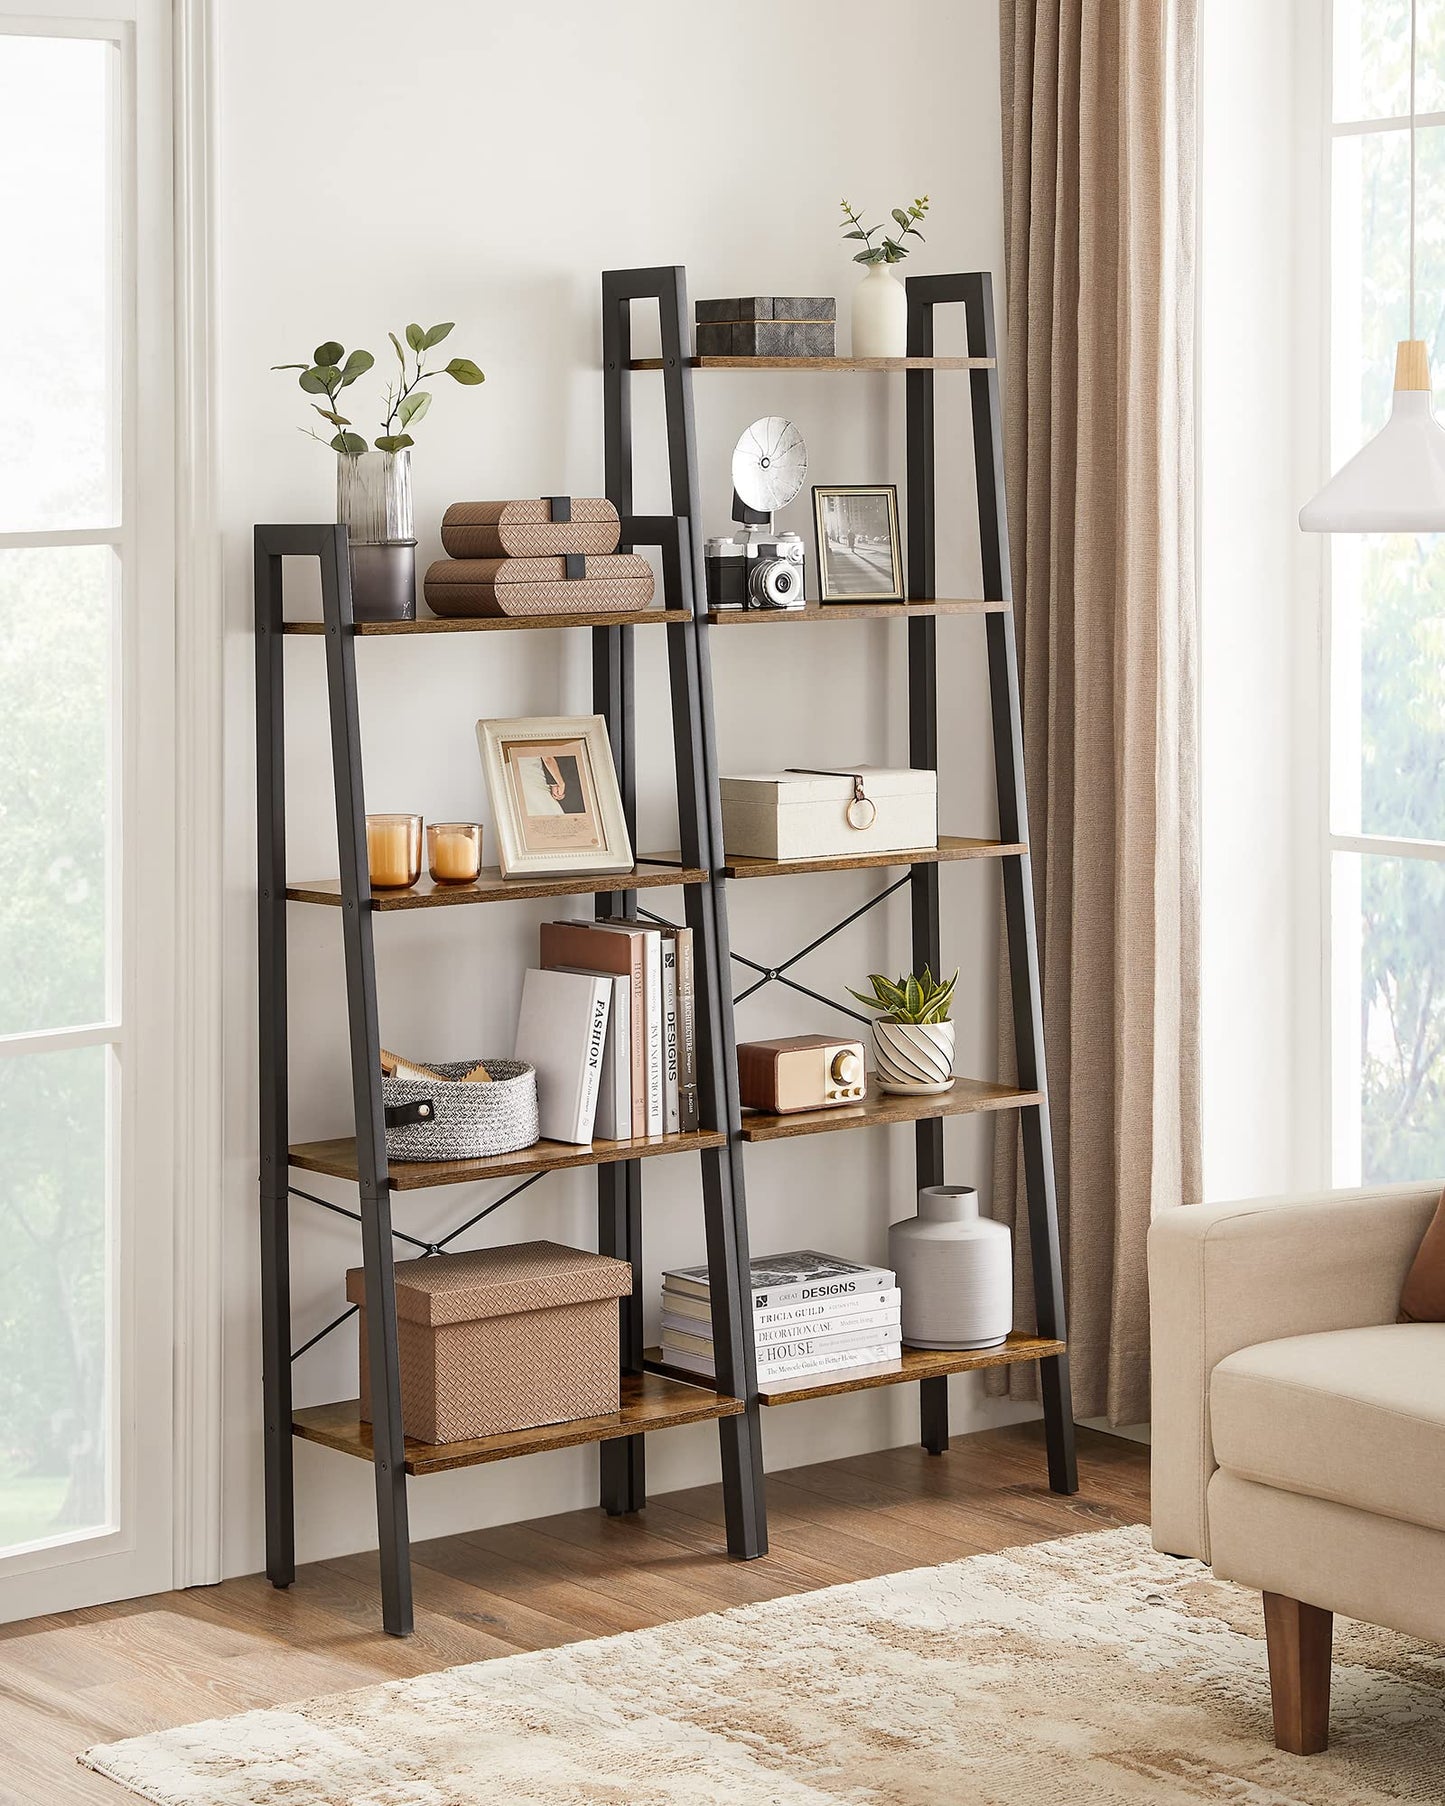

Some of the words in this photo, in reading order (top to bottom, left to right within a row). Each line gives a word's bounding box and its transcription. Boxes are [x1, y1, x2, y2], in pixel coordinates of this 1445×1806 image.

[634, 962, 642, 998] HOME
[588, 1000, 605, 1069] FASHION
[650, 1022, 658, 1048] CASE
[685, 1001, 693, 1052] ARCHITECTURE
[667, 1012, 677, 1081] DESIGNS
[651, 1049, 659, 1117] DECORATION
[779, 1292, 798, 1302] GREAT
[802, 1281, 856, 1300] DESIGNS
[759, 1310, 793, 1324] TRICIA
[795, 1306, 825, 1318] GUILD
[758, 1325, 813, 1342] DECORATION
[812, 1321, 833, 1335] CASE
[766, 1341, 815, 1361] HOUSE
[767, 1367, 778, 1375] The
[778, 1363, 801, 1373] Monocle
[801, 1359, 819, 1370] Guide
[825, 1355, 841, 1365] Better
